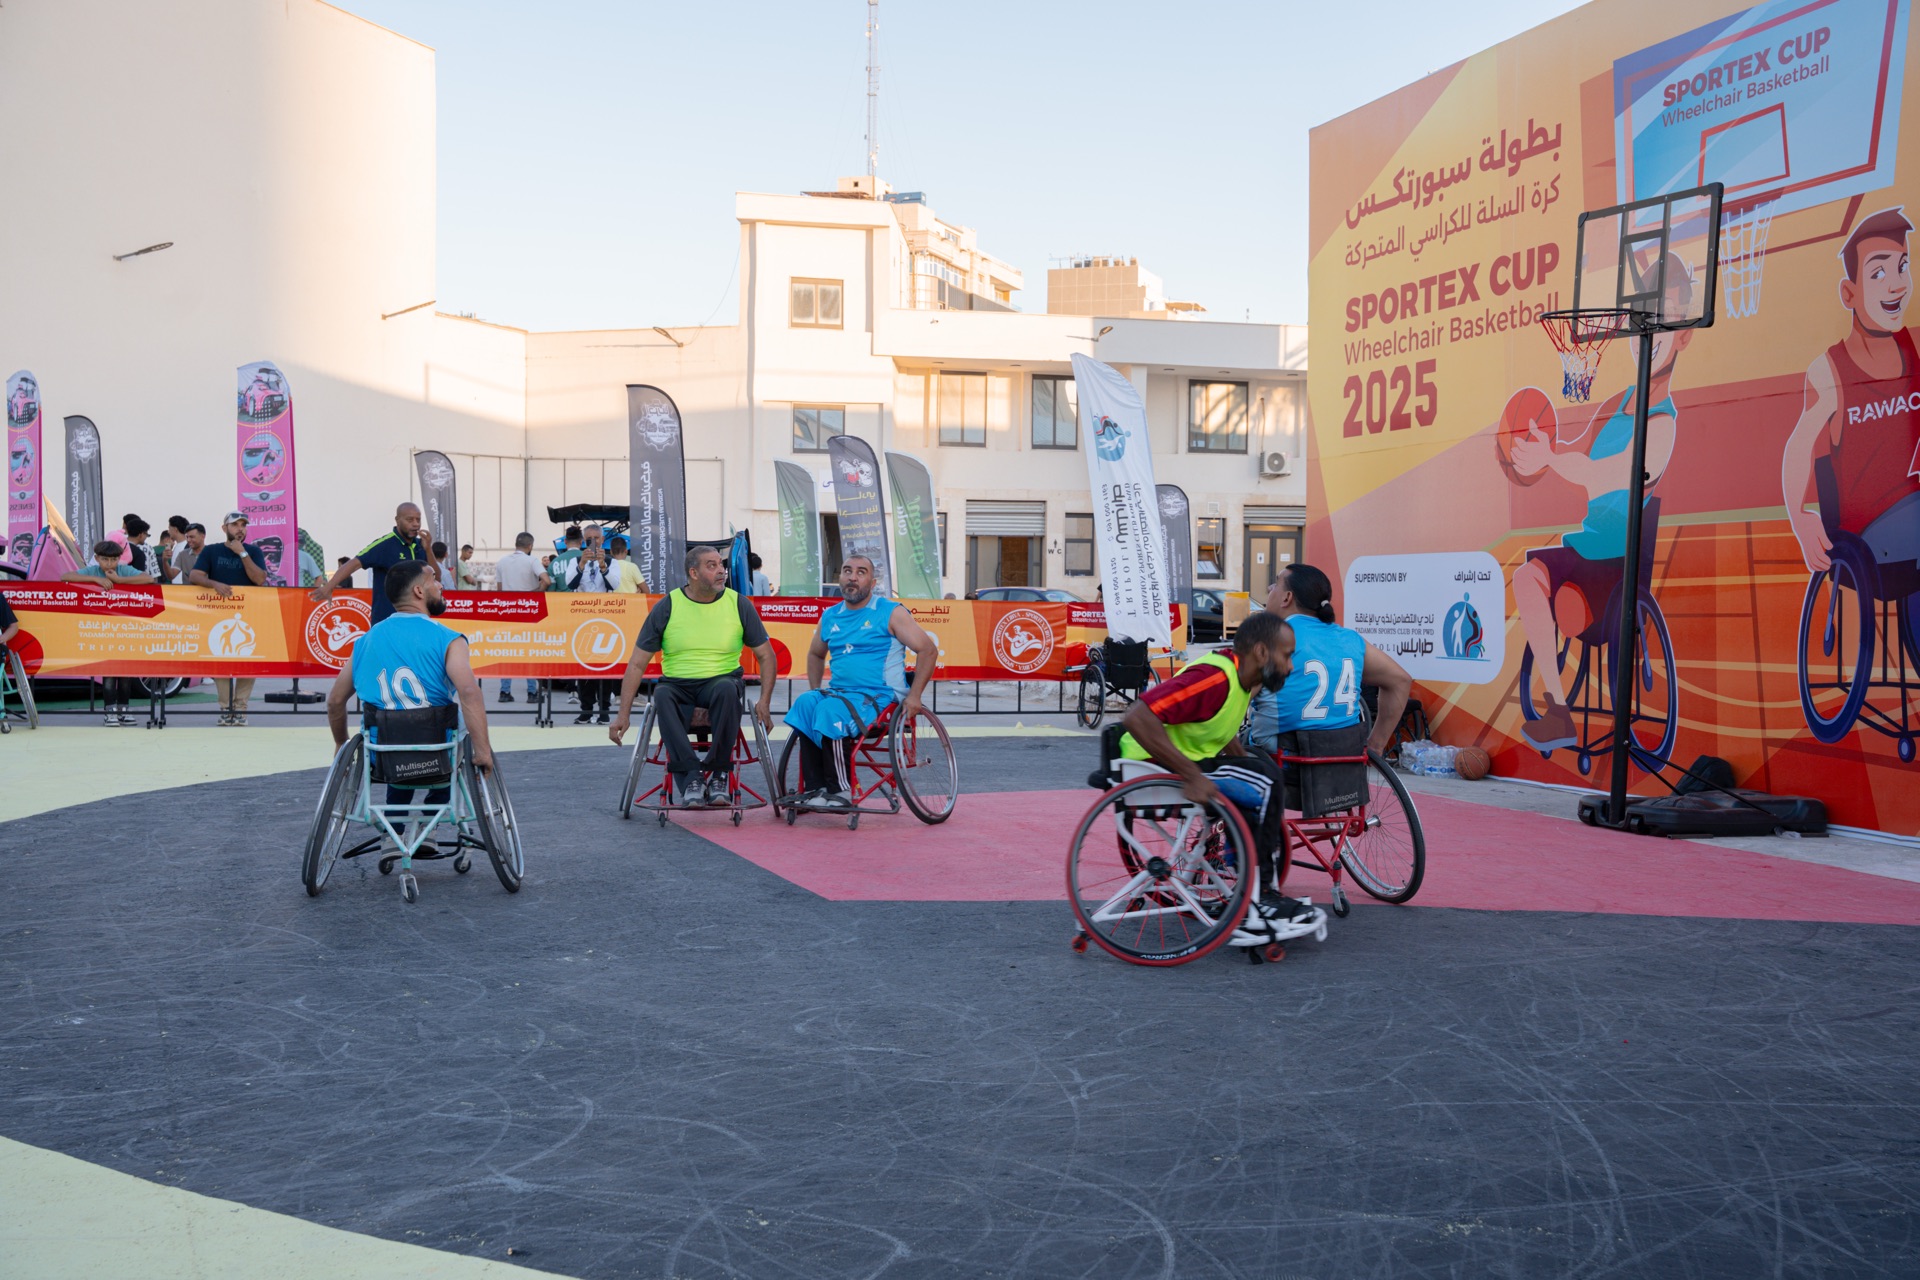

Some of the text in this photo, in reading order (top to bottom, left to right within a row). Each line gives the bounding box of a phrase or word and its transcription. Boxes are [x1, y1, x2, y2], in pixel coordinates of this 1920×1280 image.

[1662, 26, 1831, 107] SPORTEX CUP
[1662, 54, 1829, 127] Wheelchair Basketball
[1478, 118, 1562, 178] بطولة
[1345, 173, 1561, 271] كرة السلة للكراسي المتحركة
[1344, 242, 1560, 333] SPORTEX CUP
[1343, 291, 1559, 366] Wheelchair Basketball
[1343, 358, 1438, 439] 2025
[1354, 572, 1407, 583] SUPERVISION BY
[1454, 570, 1491, 583] تحت إشراف
[3, 590, 78, 600] SPORTEX CUP
[129, 592, 155, 602] بطولة
[346, 600, 372, 618] SPORTEX
[518, 598, 539, 608] بطولة
[761, 604, 800, 612] SPORTEX
[309, 600, 340, 637] SPORTEX LIYA
[486, 631, 531, 643] للهاتف
[533, 631, 567, 646] ليبيانا
[1355, 627, 1377, 635] TADAMON
[1378, 627, 1396, 635] SPORTS
[1423, 628, 1434, 636] PWD
[78, 642, 143, 652] TRIPOLI
[145, 640, 199, 656] طرابلس
[484, 649, 525, 657] MOBILE
[529, 649, 566, 657] PHONE
[1396, 638, 1433, 657] طرابلس
[377, 666, 432, 710] 10
[1301, 657, 1357, 720] 24
[395, 759, 439, 772] Multisport
[403, 767, 440, 777] motivation
[1324, 791, 1359, 805] Multisport
